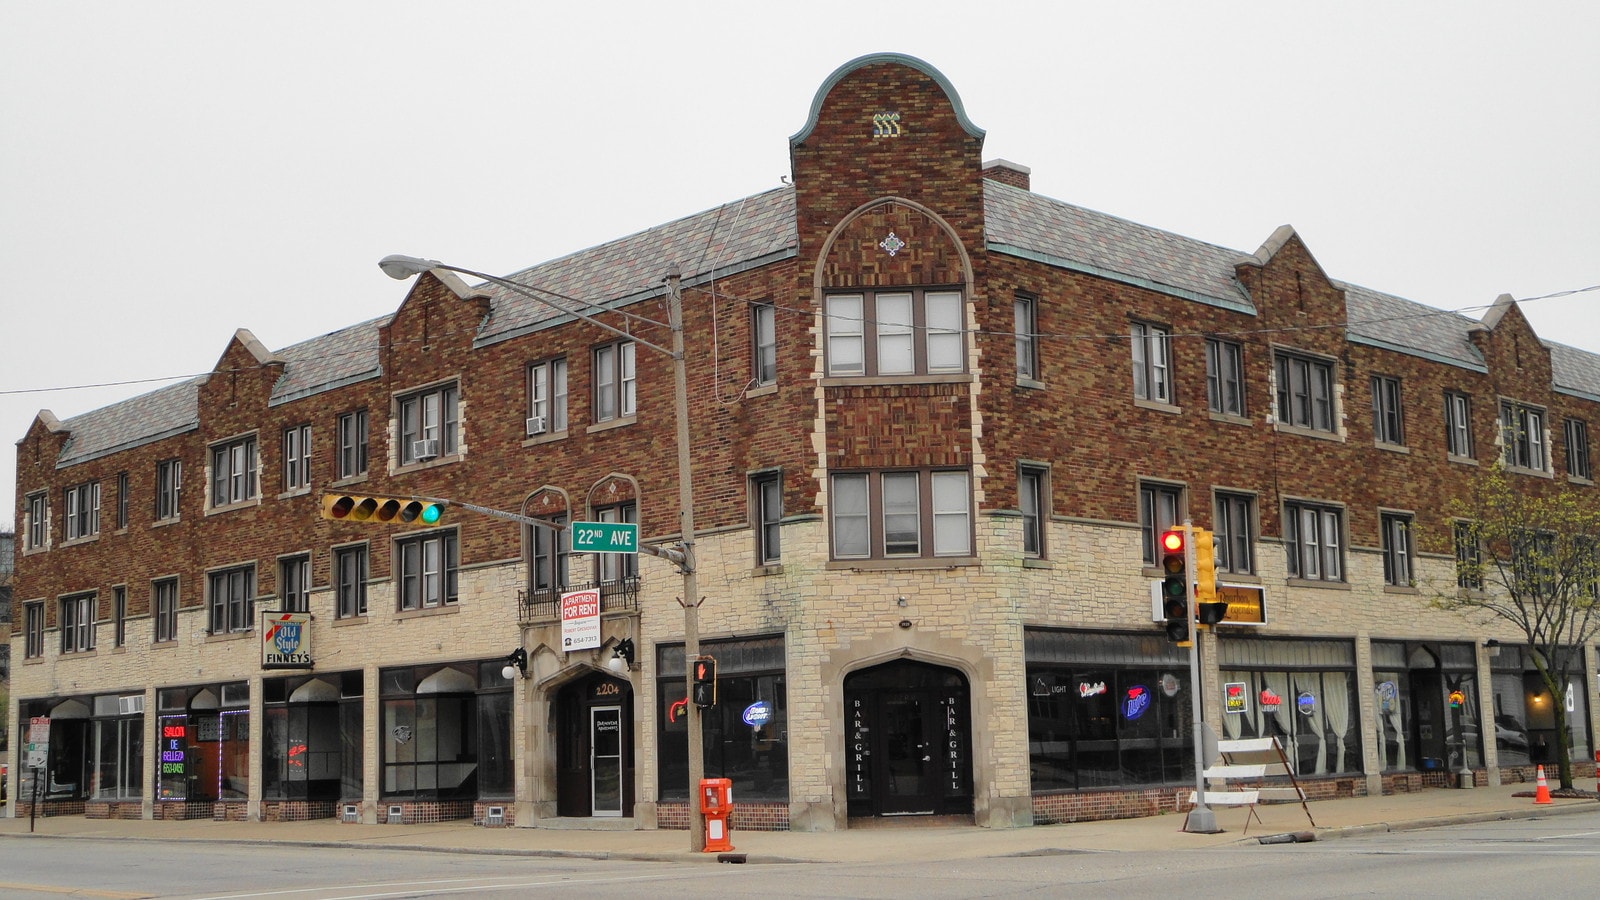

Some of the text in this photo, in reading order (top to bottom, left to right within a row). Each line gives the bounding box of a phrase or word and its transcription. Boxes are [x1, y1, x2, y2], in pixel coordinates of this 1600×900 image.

[577, 529, 632, 546] 22ND AVE
[564, 594, 597, 607] APARTMENT
[564, 603, 597, 619] FOR RENT
[280, 626, 296, 639] Old
[276, 636, 299, 653] Style
[266, 651, 310, 663] FINNEY'S
[596, 683, 620, 695] 2204
[1051, 685, 1067, 694] LIGHT
[163, 726, 185, 737] SALON
[170, 739, 179, 750] DE
